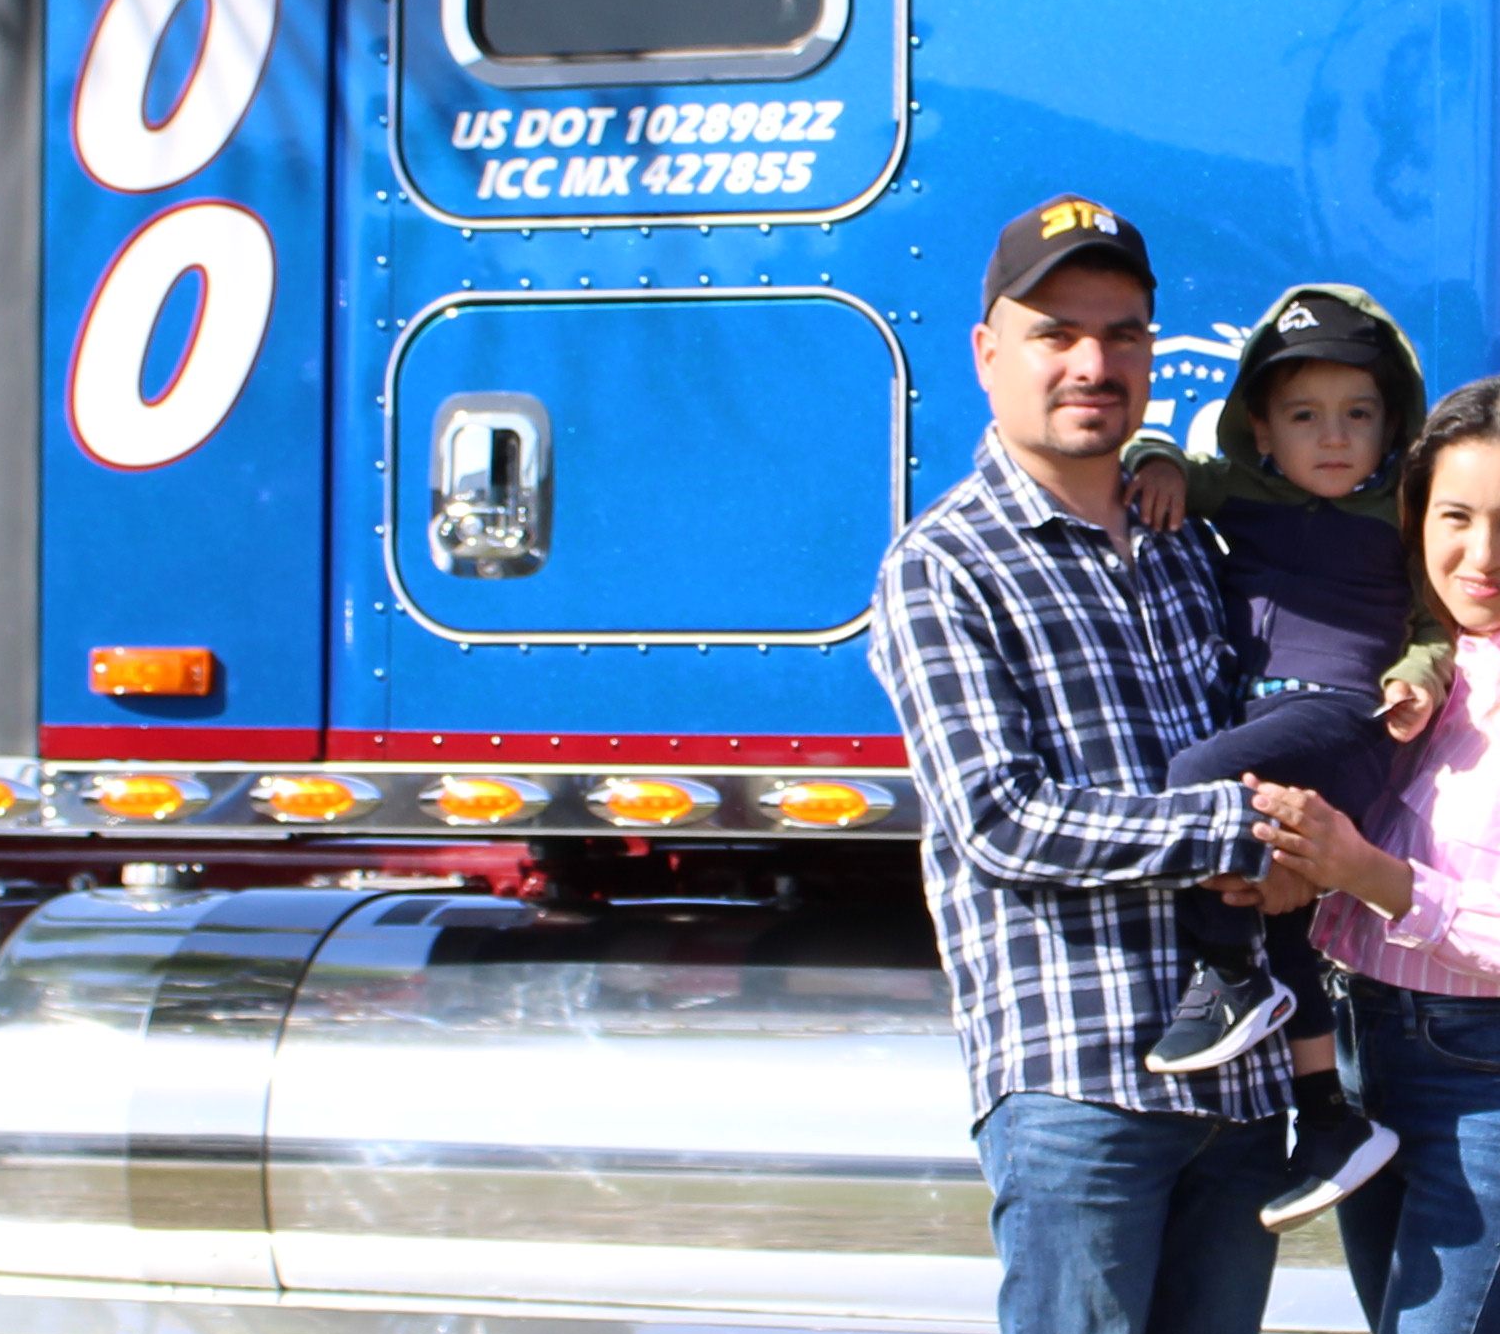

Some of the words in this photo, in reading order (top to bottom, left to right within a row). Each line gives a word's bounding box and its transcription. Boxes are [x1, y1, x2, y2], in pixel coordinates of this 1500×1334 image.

[451, 109, 512, 150] US
[514, 106, 617, 148] DOT
[626, 100, 845, 144] 1028982Z
[477, 156, 558, 199] ICC
[559, 155, 639, 198] MX
[640, 151, 817, 195] 427855
